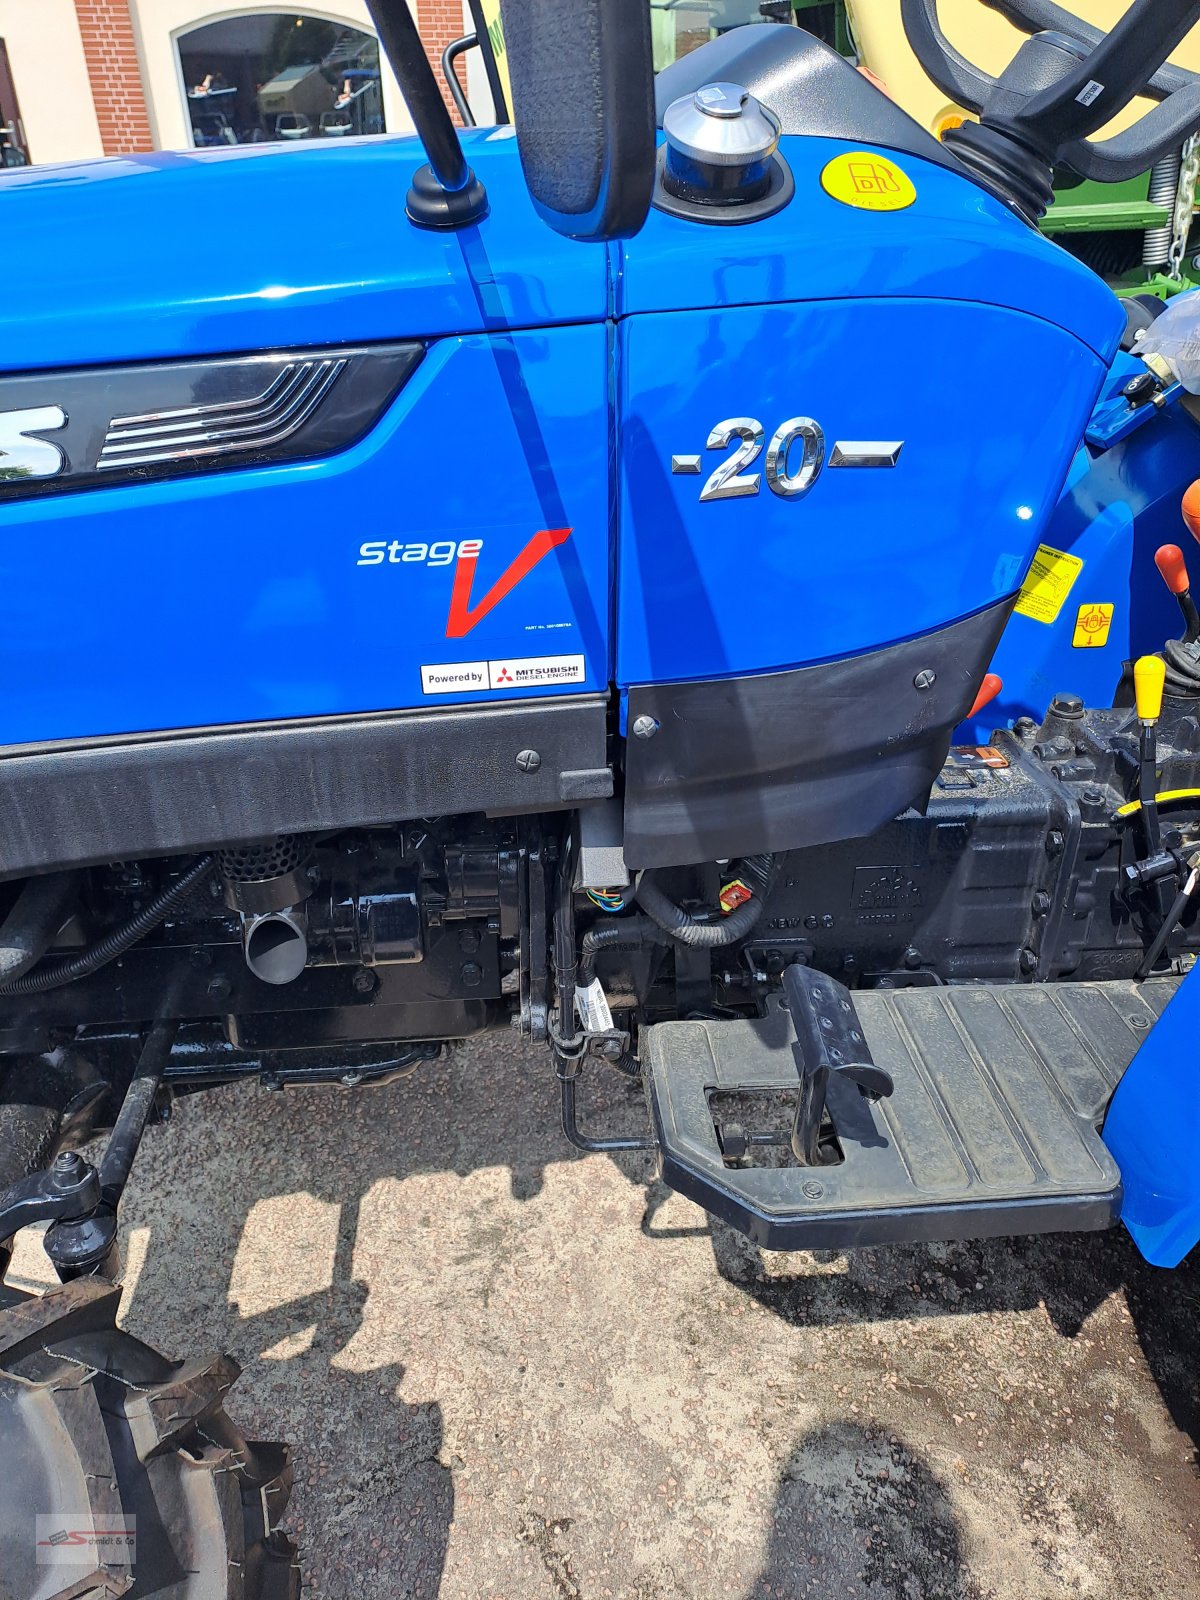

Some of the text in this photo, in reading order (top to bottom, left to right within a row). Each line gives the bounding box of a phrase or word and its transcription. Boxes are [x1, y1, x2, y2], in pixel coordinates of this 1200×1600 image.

[357, 539, 484, 566] Stage
[445, 528, 574, 638] V
[516, 666, 579, 675] MITSUBISHI
[516, 670, 579, 682] DIESEL ENGINE
[428, 672, 483, 683] Powered by
